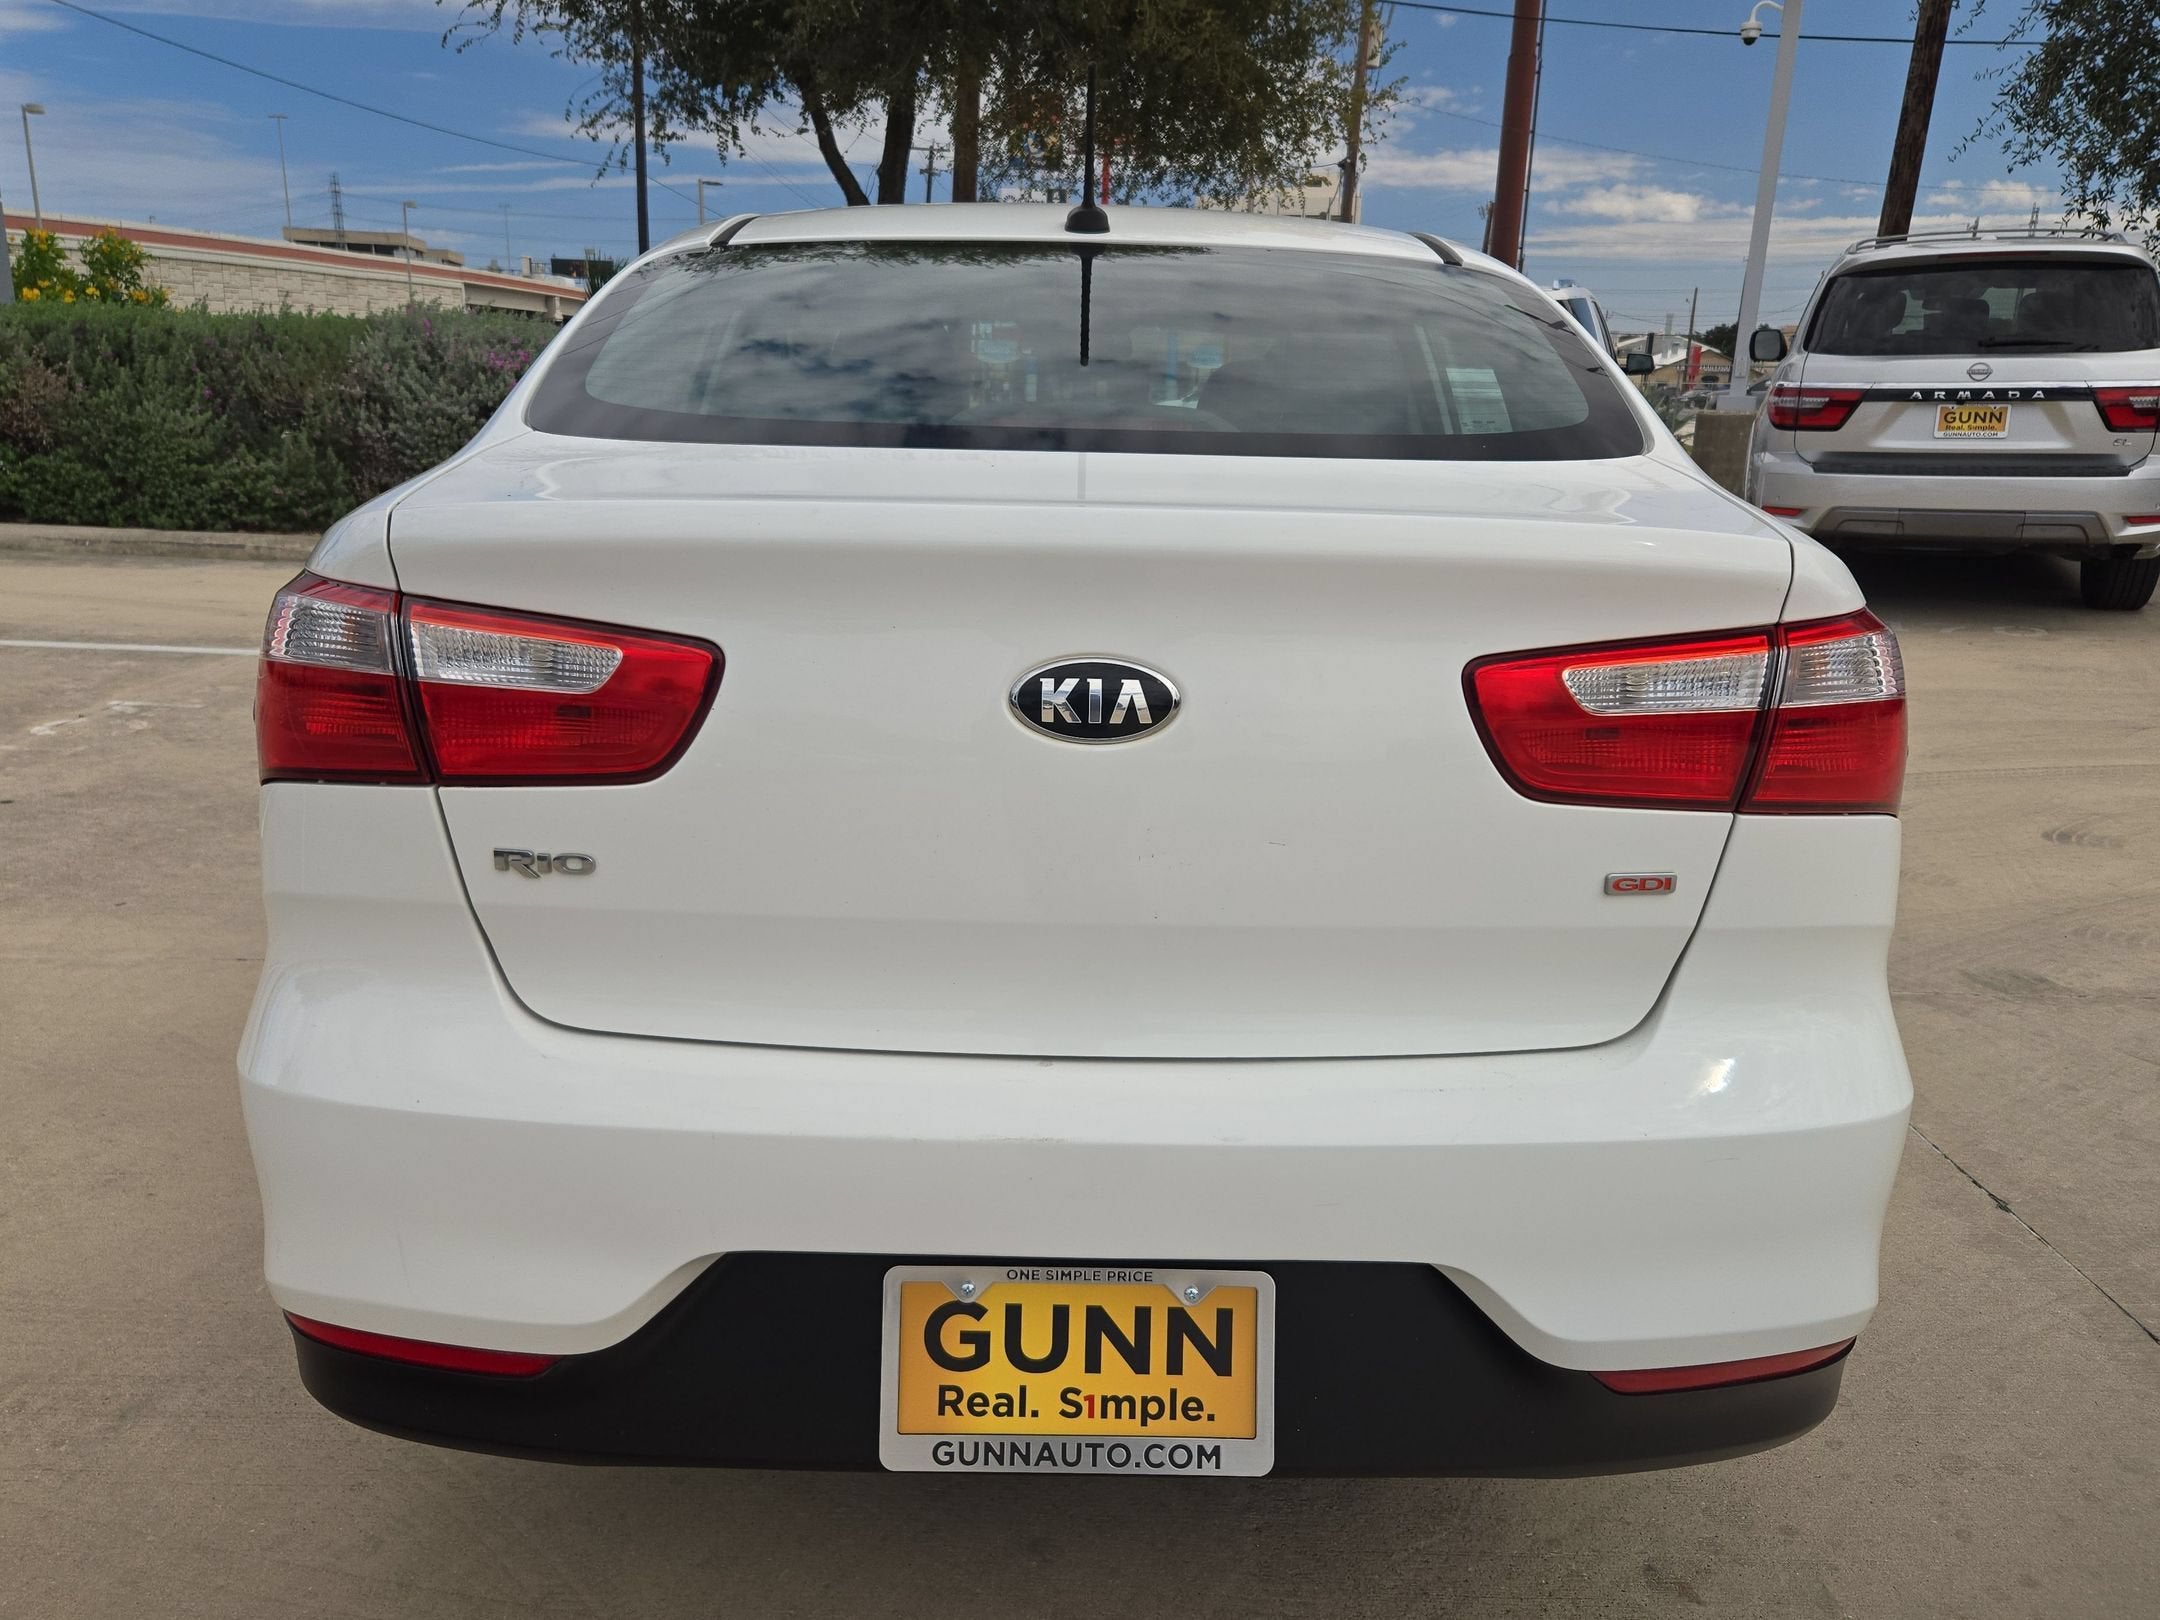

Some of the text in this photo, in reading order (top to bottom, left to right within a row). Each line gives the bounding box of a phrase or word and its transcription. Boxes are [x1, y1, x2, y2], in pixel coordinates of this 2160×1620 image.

[1910, 390, 2045, 399] ARMADA
[1943, 411, 2003, 424] GUNN
[1040, 678, 1152, 724] KIA
[1612, 877, 1672, 891] GDI
[1006, 1269, 1153, 1282] ONE SIMPLE PRICE
[923, 1300, 1234, 1377] GUNN
[937, 1384, 1039, 1418] Real.
[932, 1440, 1221, 1470] GUNNAUTO.COM
